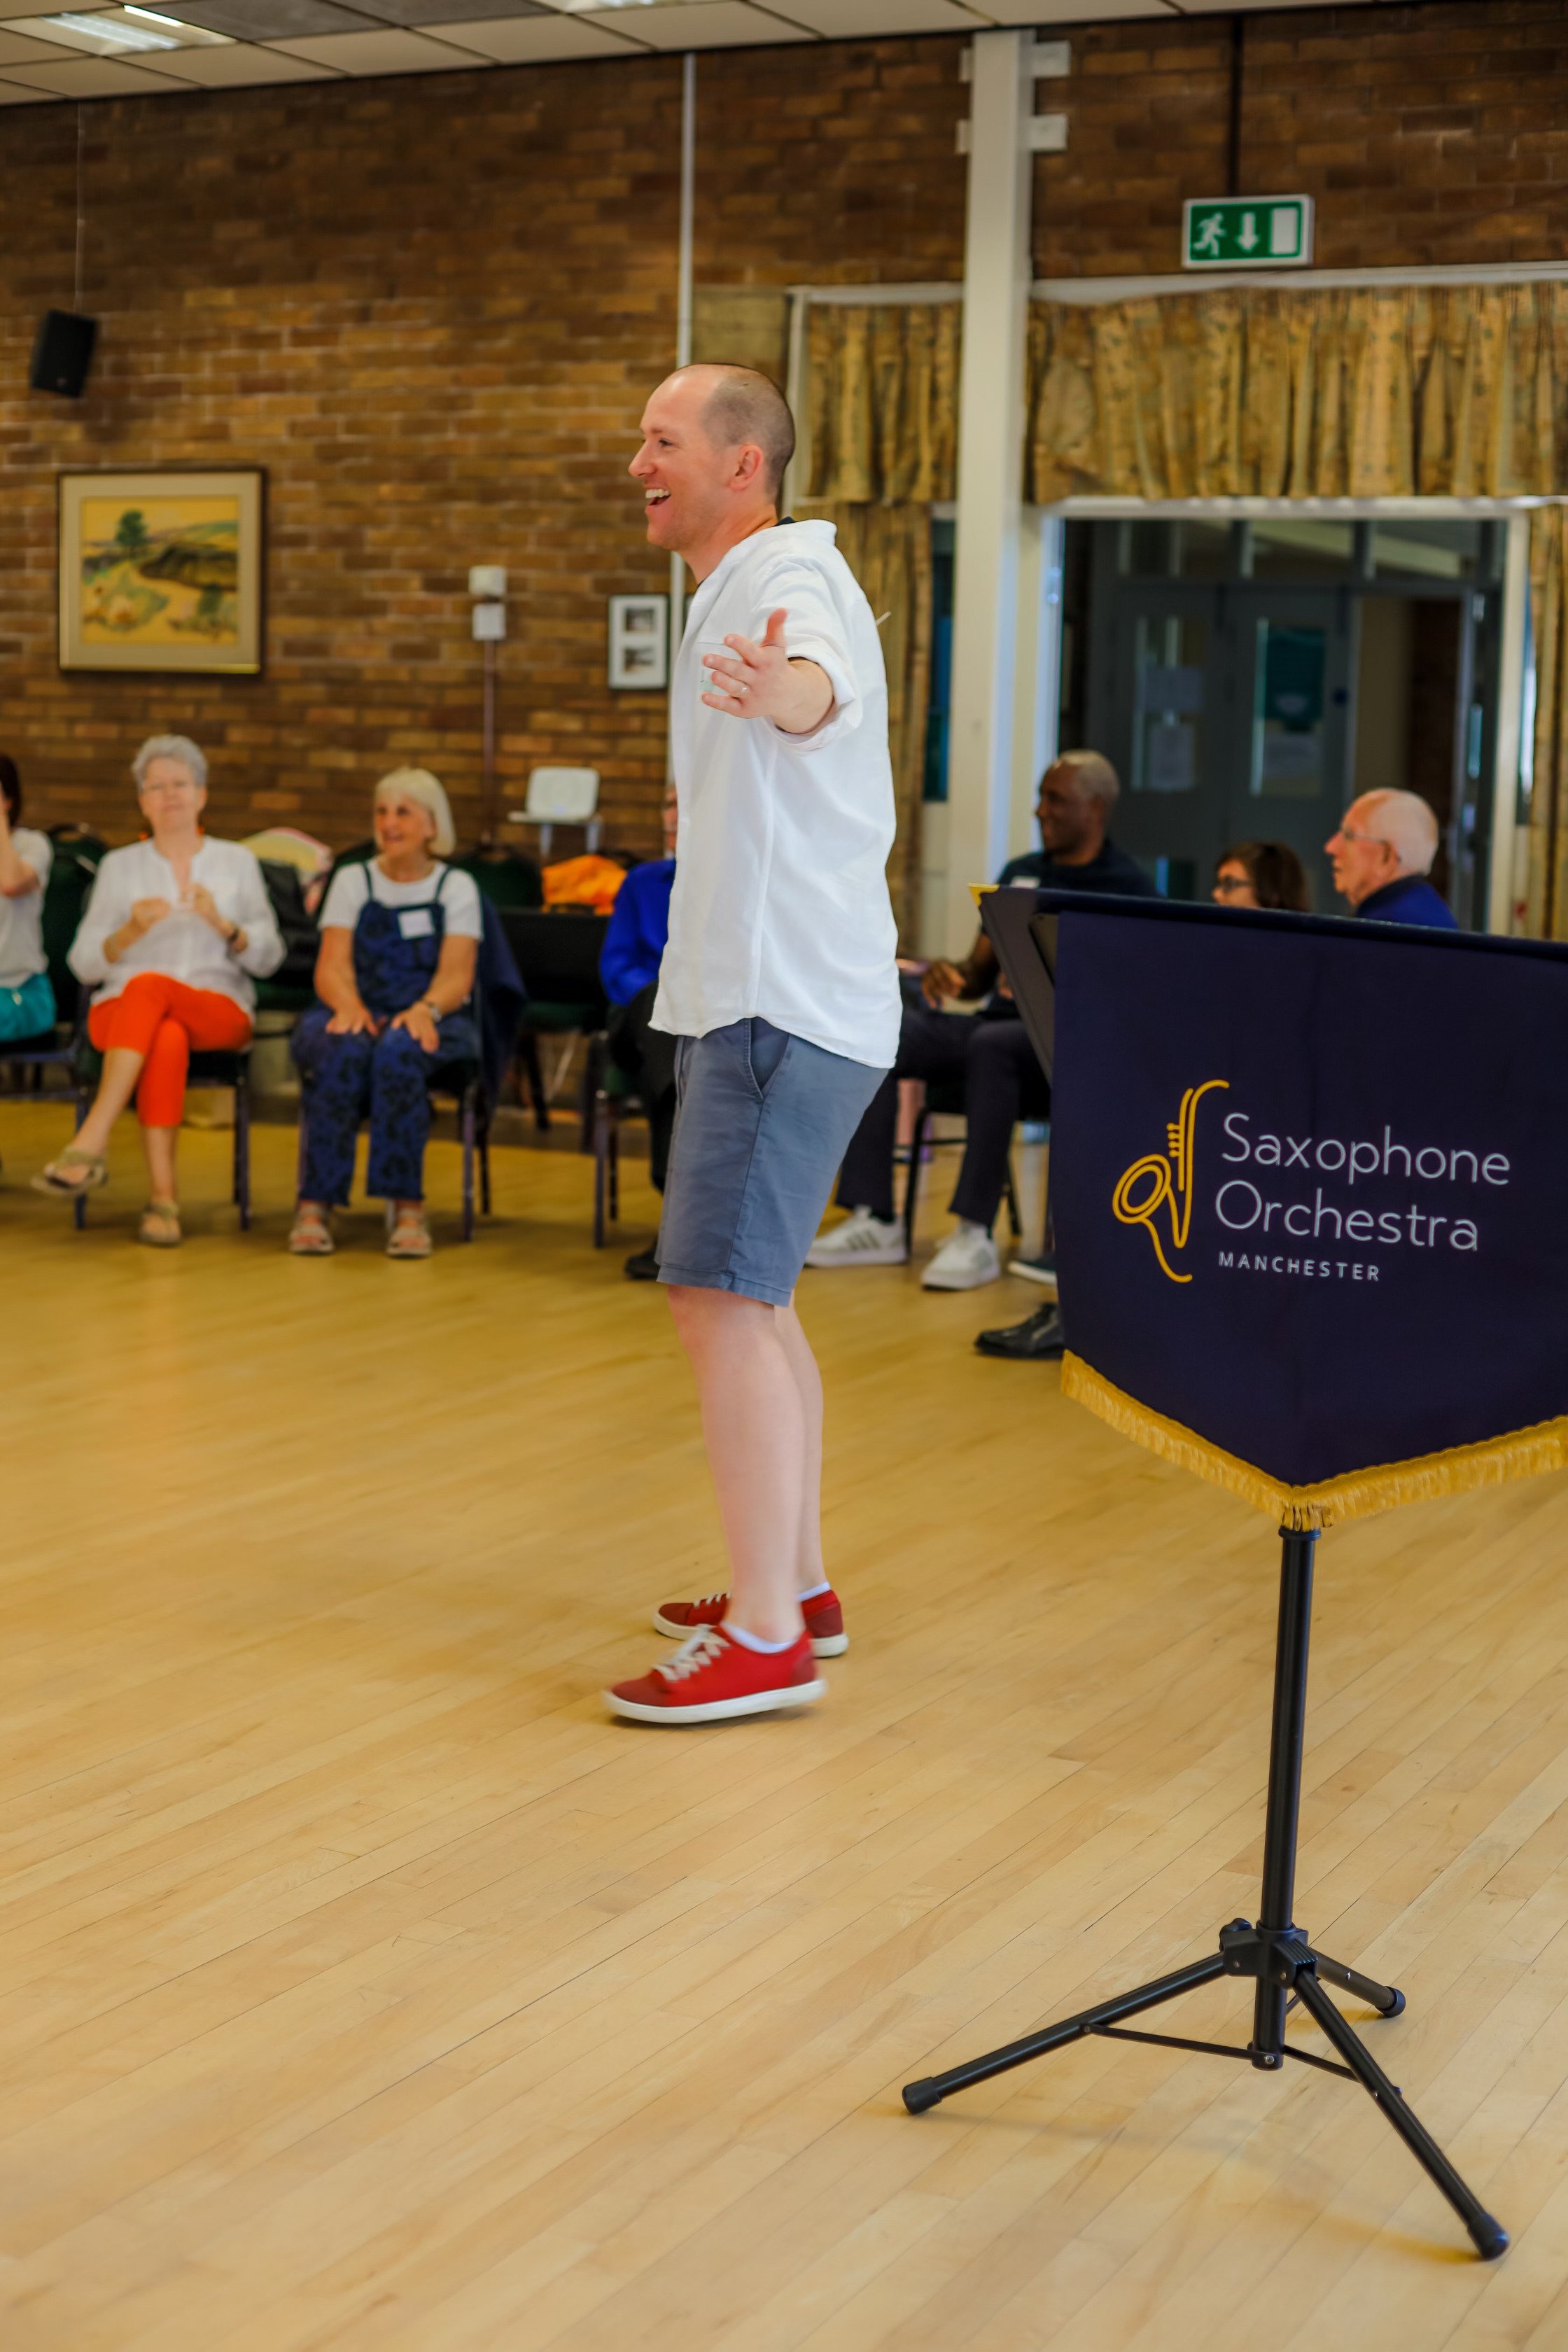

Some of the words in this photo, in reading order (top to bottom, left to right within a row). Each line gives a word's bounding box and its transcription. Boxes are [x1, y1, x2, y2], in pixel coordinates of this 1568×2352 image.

[1222, 1112, 1511, 1185] Saxophone
[1215, 1180, 1478, 1251] Orchestra
[1218, 1251, 1380, 1282] MANCHESTER
